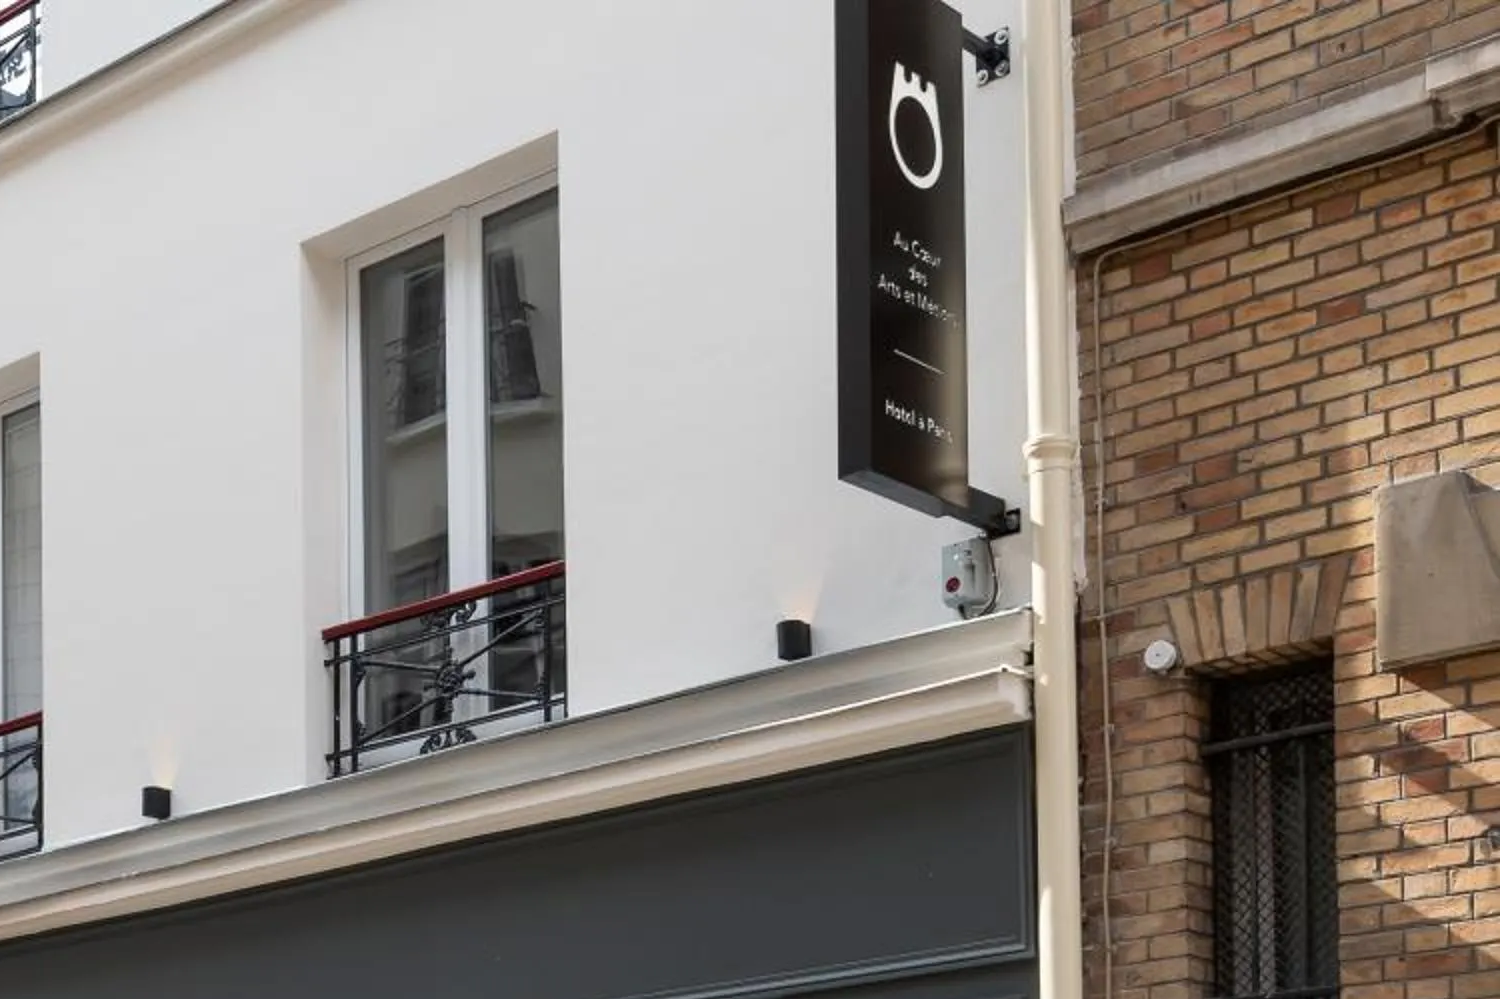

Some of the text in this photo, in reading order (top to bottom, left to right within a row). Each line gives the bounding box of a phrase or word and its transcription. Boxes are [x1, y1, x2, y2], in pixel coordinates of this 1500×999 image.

[893, 231, 909, 251] Au
[908, 264, 928, 287] des
[878, 272, 901, 299] Arts
[903, 290, 915, 305] et
